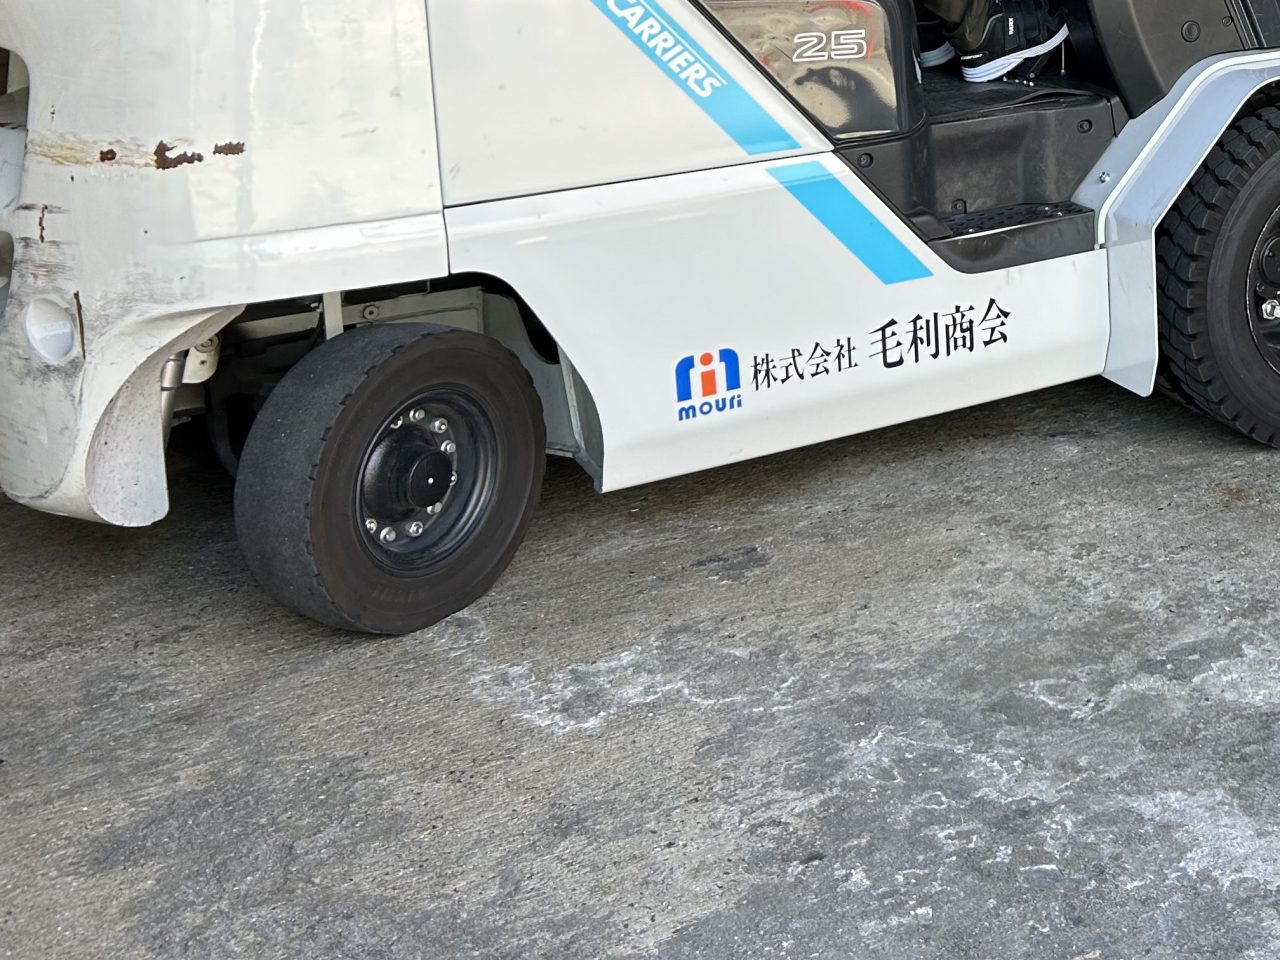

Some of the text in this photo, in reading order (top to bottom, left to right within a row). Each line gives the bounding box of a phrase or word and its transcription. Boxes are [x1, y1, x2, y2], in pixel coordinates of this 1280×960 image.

[792, 29, 867, 63] 25
[751, 297, 1012, 391] 株式会社 毛利商会
[678, 394, 742, 421] mouri
